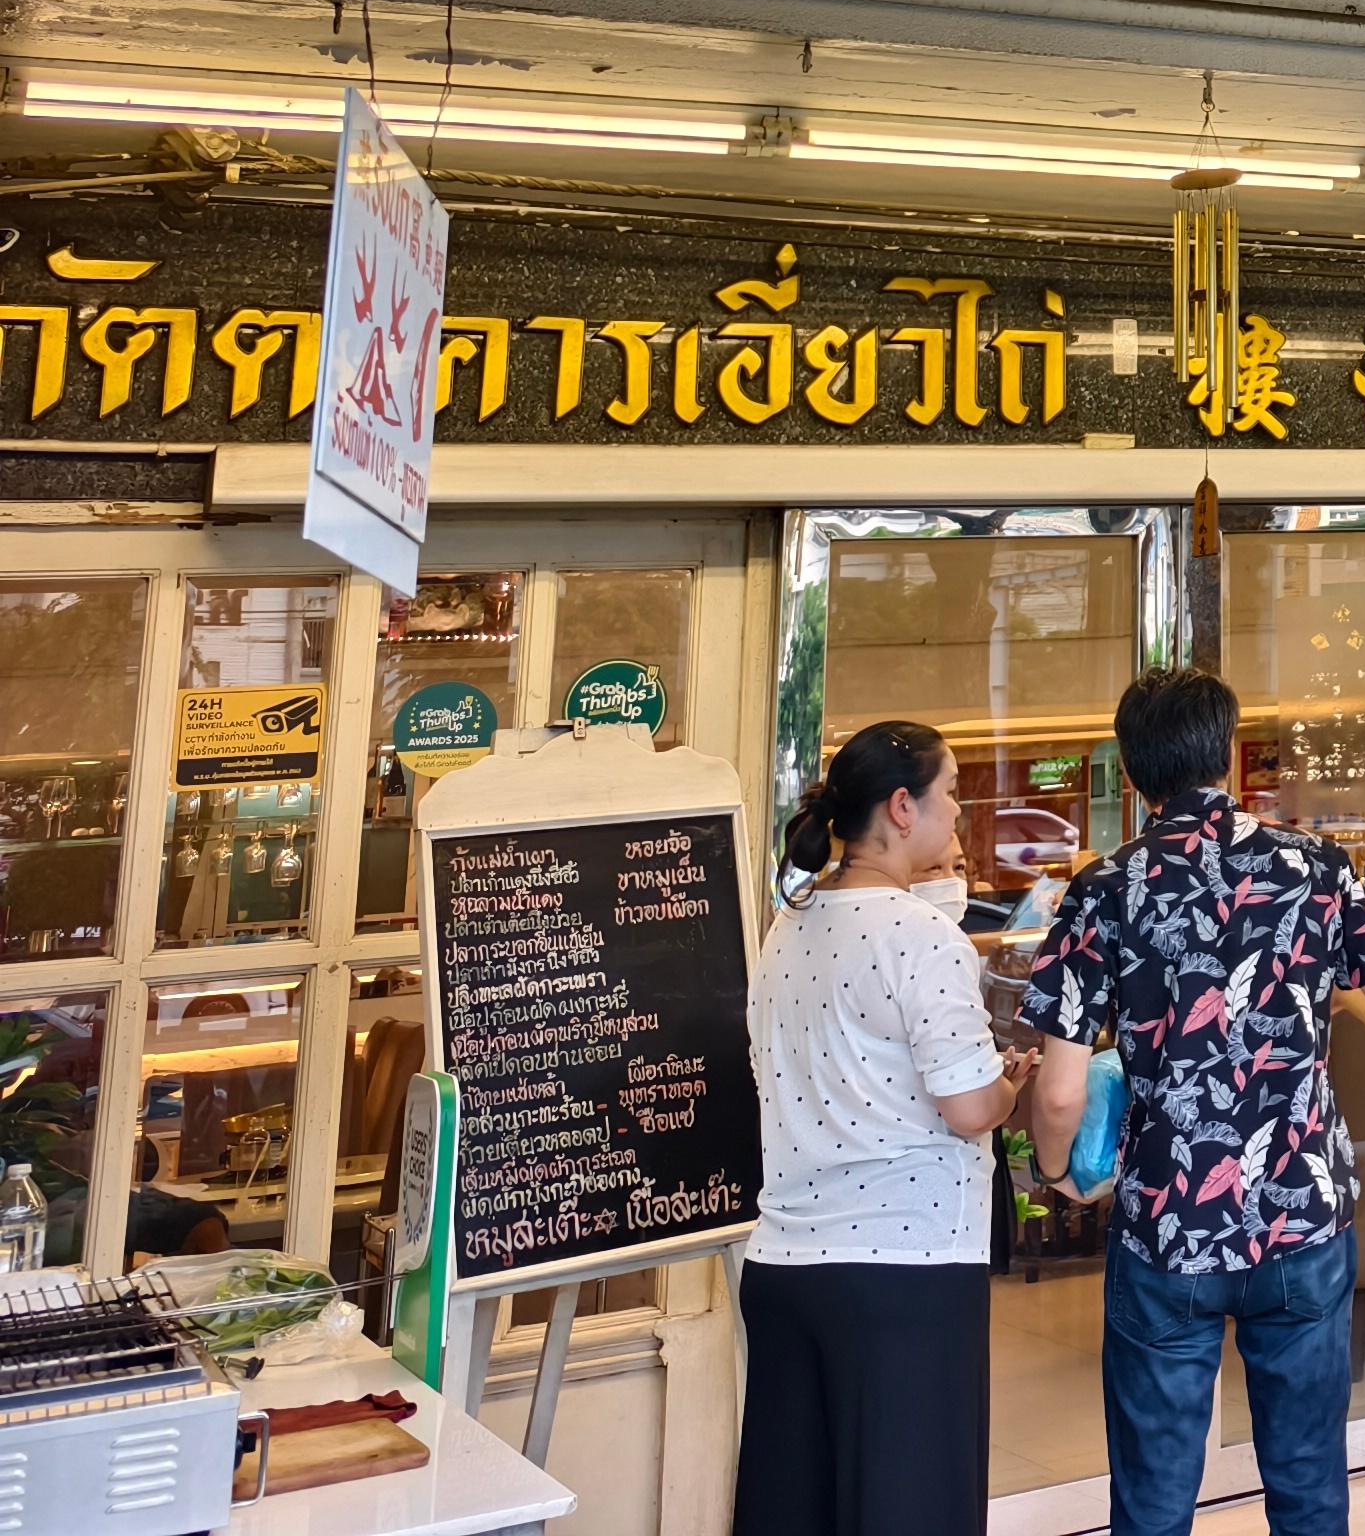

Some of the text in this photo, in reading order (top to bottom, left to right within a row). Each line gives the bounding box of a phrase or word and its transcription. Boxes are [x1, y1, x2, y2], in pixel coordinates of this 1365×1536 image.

[0, 241, 1066, 427] ัตตคารเอี่ยวไถ่
[579, 681, 627, 696] #Grab
[187, 697, 223, 711] 24H
[578, 686, 649, 713] Thumbs
[187, 712, 223, 721] VIDEO
[419, 707, 452, 718] #Grab
[621, 700, 643, 720] Up
[186, 720, 254, 730] SURVEILLANCE
[418, 710, 467, 731] Thumbs
[448, 718, 464, 733] Up
[184, 731, 256, 744] CCTV กำลังทำงาน
[407, 734, 479, 747] AWARDS 2025
[183, 742, 286, 757] เพื่อรักษาความปลอดภัย
[624, 828, 692, 859] หอยจ้อ
[450, 840, 556, 881] กุ้งแม่น้ำเผา
[617, 854, 707, 897] ขาหมูเย็น
[614, 891, 710, 926] ข้าวอบเผือก
[460, 1073, 566, 1111] ก่ไทยแช่เหล้า
[619, 1079, 707, 1115] พุทราทอด
[465, 1169, 743, 1264] หมูสะเต๊ะ เนื้อสะเต๊ะ
